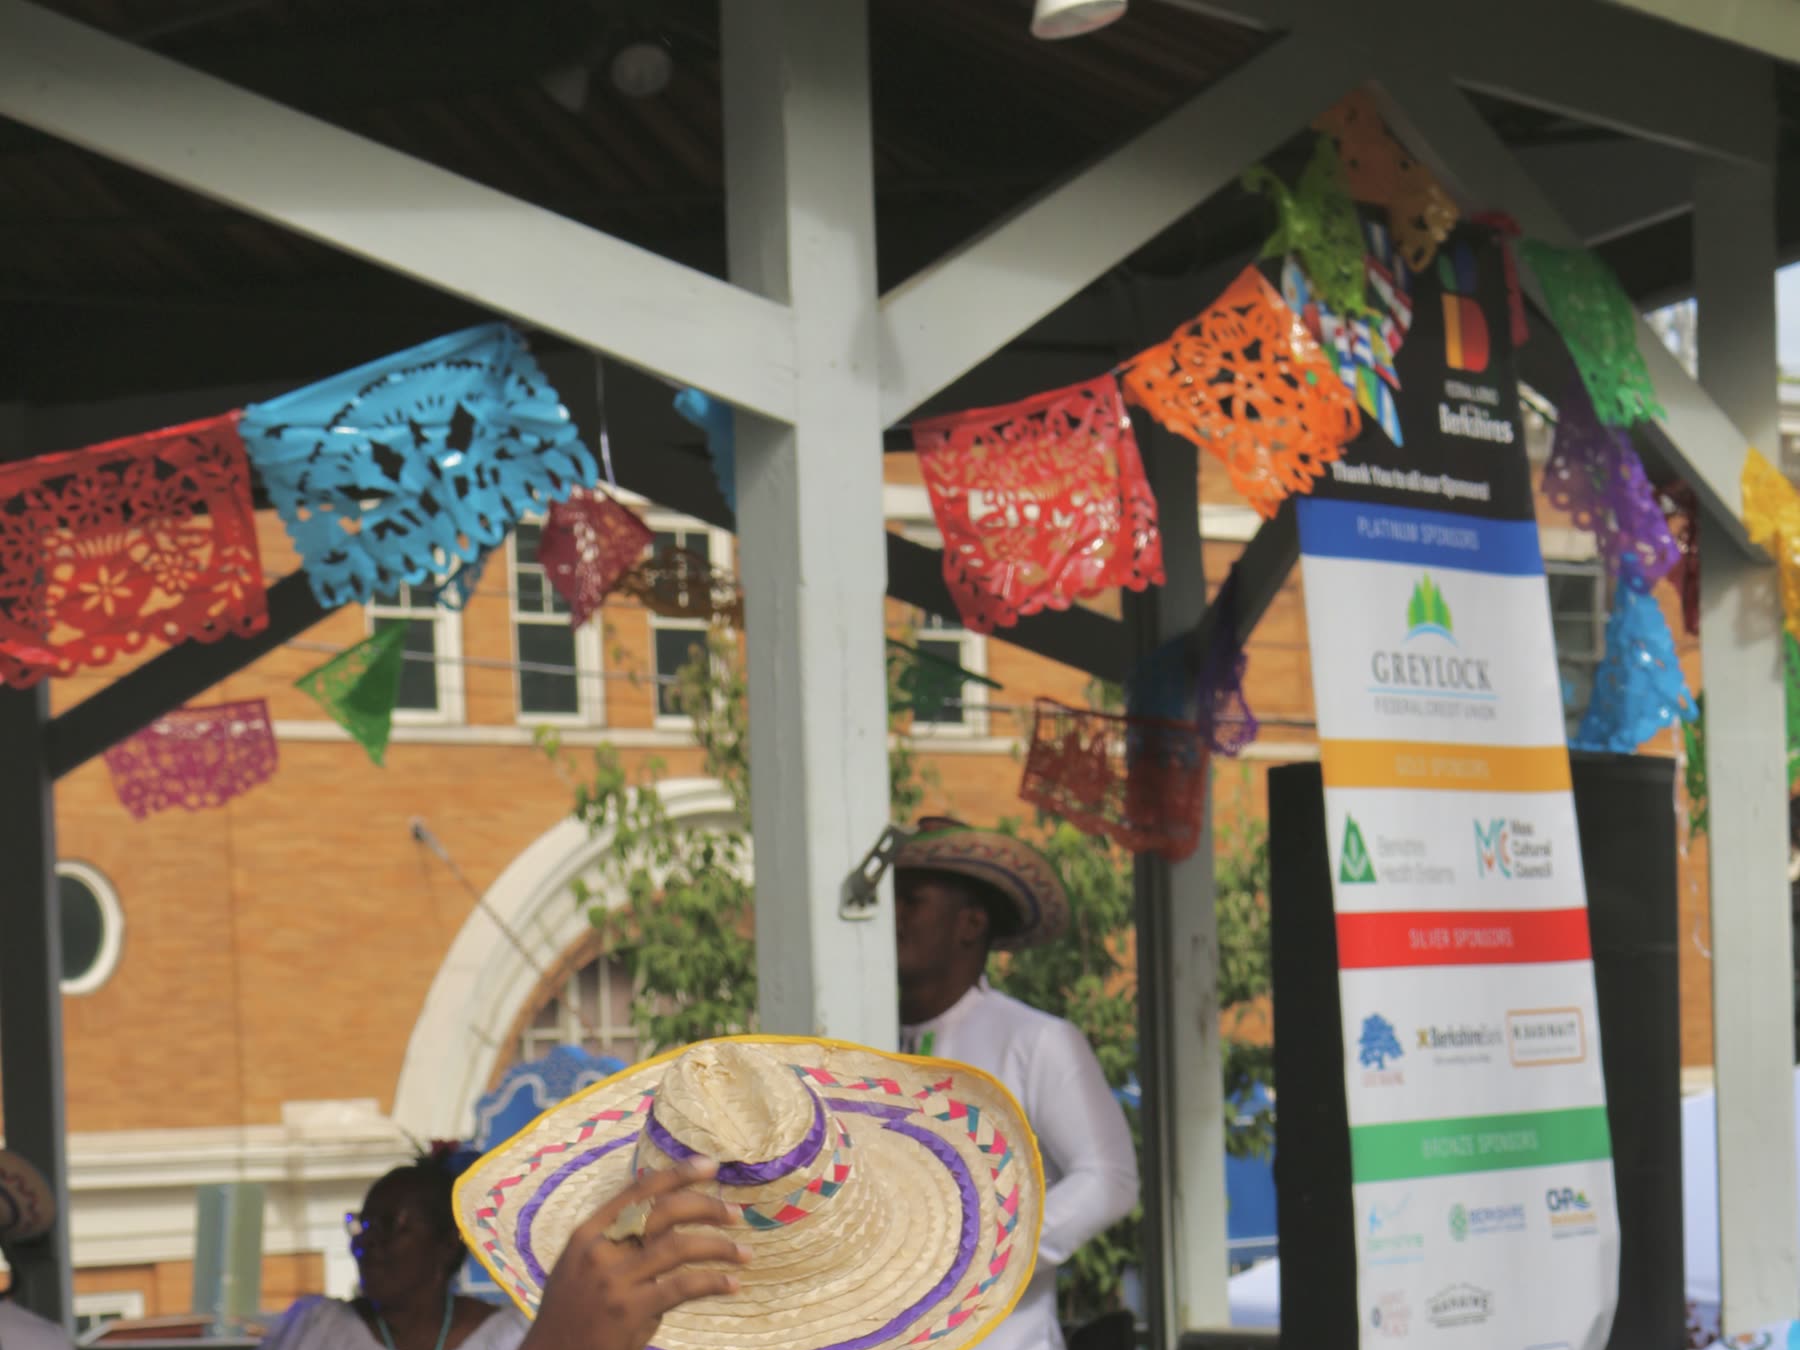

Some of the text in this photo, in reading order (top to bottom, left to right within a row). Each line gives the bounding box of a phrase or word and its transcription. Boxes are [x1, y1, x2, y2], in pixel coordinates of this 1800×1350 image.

[1331, 460, 1371, 485] Thank
[1356, 515, 1418, 543] PLATINUM
[1371, 651, 1493, 690] GREYLOCK
[1408, 926, 1514, 950] SILVER SPONSORS
